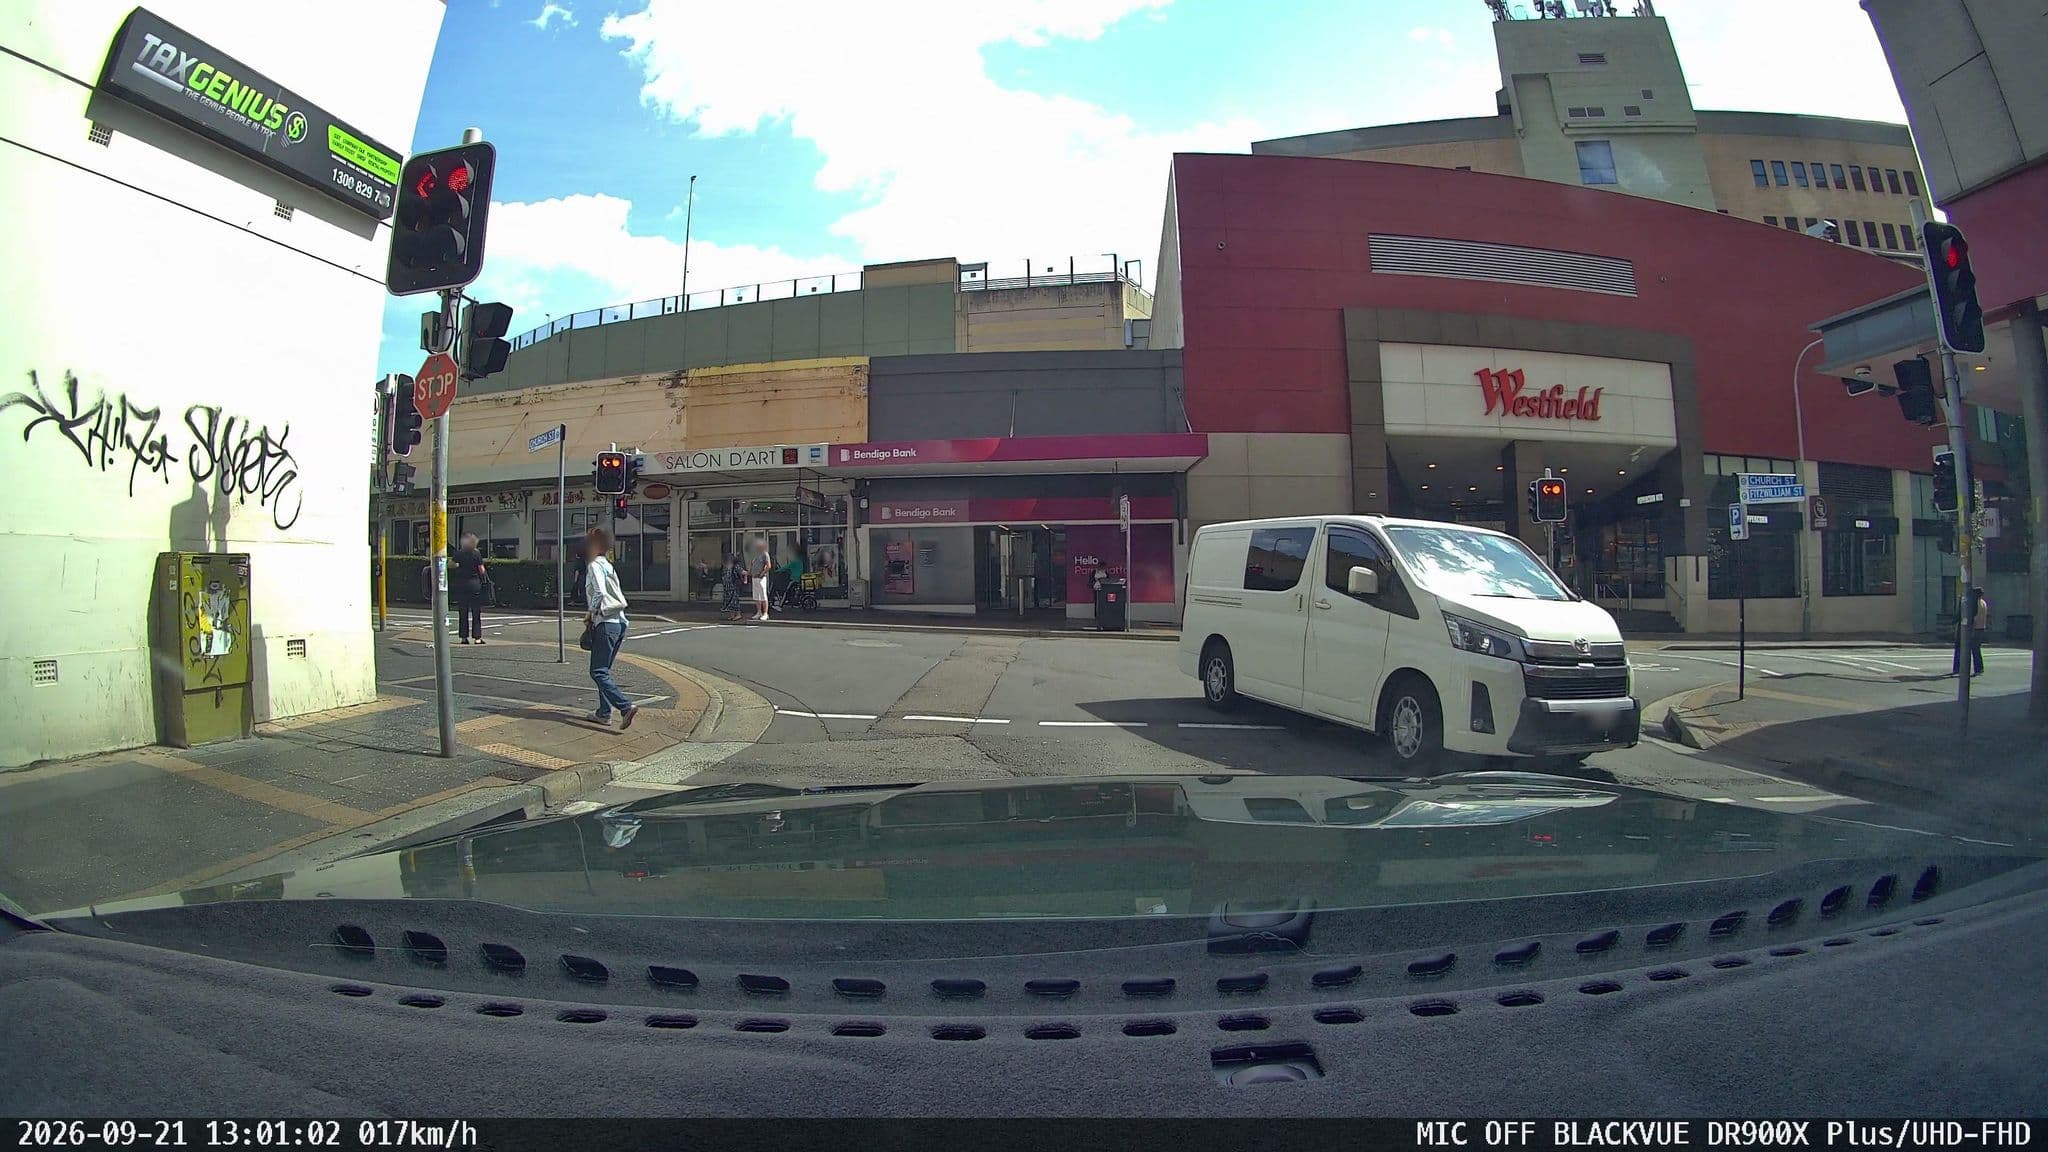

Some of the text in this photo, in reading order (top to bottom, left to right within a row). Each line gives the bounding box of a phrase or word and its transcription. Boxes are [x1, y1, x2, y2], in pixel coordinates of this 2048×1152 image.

[200, 95, 226, 114] GENIUS
[225, 110, 252, 128] PEOPLE
[251, 121, 261, 131] IN
[333, 168, 354, 190] 1300
[355, 180, 373, 199] 829
[418, 373, 454, 401] STOP
[1474, 367, 1605, 421] Westfield
[666, 452, 721, 470] SALON
[729, 450, 776, 467] D'ART
[854, 448, 917, 460] Bendigo Bank
[1749, 476, 1795, 485] CHURCH ST
[1749, 486, 1803, 499] FITZWILLIAM ST
[895, 507, 957, 519] Bendigo Bank
[1732, 509, 1740, 524] P
[1074, 555, 1099, 565] Hello
